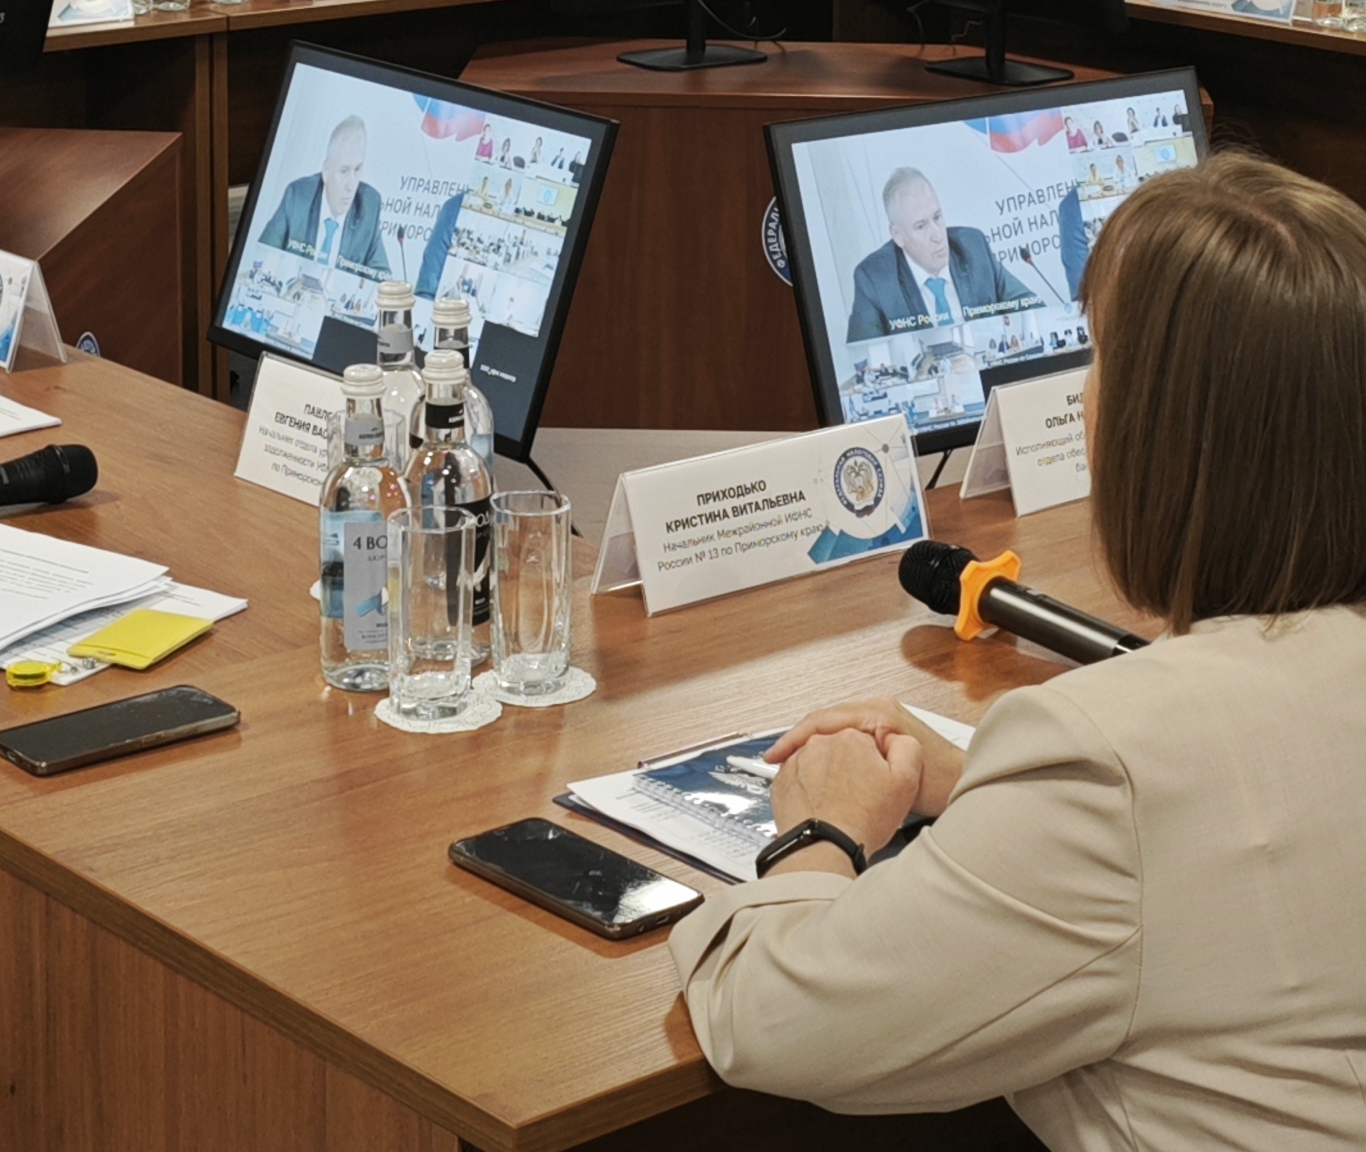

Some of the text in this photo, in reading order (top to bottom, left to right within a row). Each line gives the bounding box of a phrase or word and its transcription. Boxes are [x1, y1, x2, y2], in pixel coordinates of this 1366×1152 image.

[274, 411, 311, 434] ЕВГЕНИЯ
[1045, 411, 1076, 429] ОЛЬГА
[696, 479, 768, 507] ПРИХОДЬКО
[665, 489, 807, 535] КРИСТИНА ВИТАЛЬЕВНА
[352, 535, 363, 550] 4
[662, 507, 813, 554] Начальник Межрайонной ИФНС
[657, 554, 694, 573] России
[708, 548, 720, 561] 13
[720, 545, 733, 557] по
[735, 529, 799, 555] Приморскому
[799, 523, 824, 540] краю
